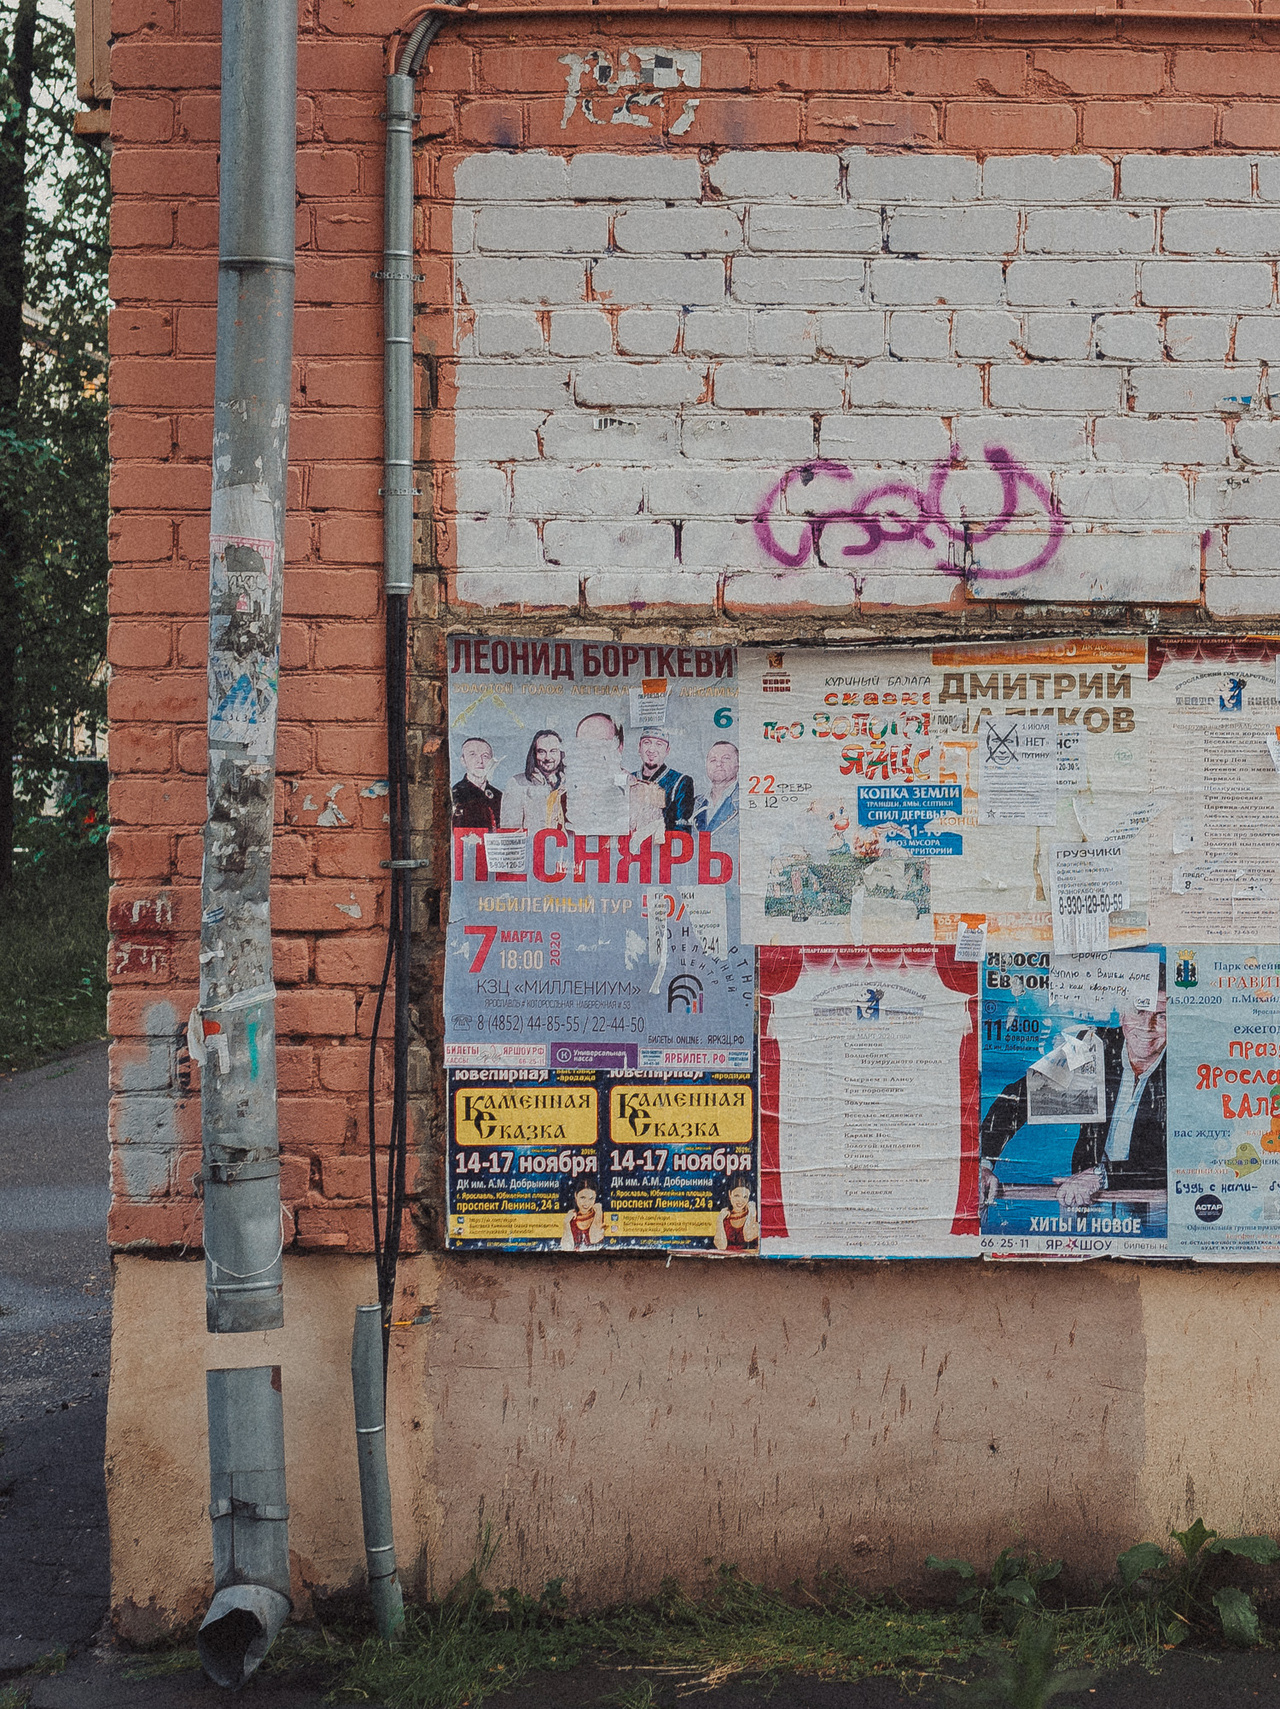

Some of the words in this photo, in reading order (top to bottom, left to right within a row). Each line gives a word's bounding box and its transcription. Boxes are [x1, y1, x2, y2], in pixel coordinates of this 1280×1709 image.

[451, 639, 574, 680] ЛЕОНИД
[582, 643, 738, 678] БОРТКЕВИ
[825, 676, 879, 687] КУРИНЫЙ
[939, 665, 1131, 704] ДМИТРИЙ
[749, 775, 776, 794] 22
[859, 786, 909, 799] КОПКА
[912, 786, 960, 799] ЗЕМЛИ
[868, 810, 900, 821] СПИЛ
[908, 839, 941, 847] МУСОРА
[1057, 848, 1121, 858] ГРУЗЧИКИ
[478, 895, 597, 914] ЮБИЛЕЙНЫЙ
[601, 897, 633, 914] ТУР
[464, 925, 498, 974] 7
[500, 930, 543, 943] МАРТА
[550, 931, 561, 966] 2020
[500, 950, 544, 970] 18:00
[1214, 962, 1241, 972] Парк
[477, 979, 509, 996] КЗЦ
[515, 980, 641, 995] «МИЛЛЕНИУМ»
[1169, 996, 1222, 1005] 15.02.2020
[477, 1015, 484, 1030] 8
[488, 1015, 524, 1033] (4852)
[527, 1015, 579, 1032] 44-85-55
[592, 1016, 645, 1032] 22-44-50
[984, 1019, 1001, 1040] 11
[446, 1046, 479, 1054] БИЛЕТЫ
[713, 1054, 726, 1064] РФ
[1196, 1129, 1231, 1140] ждут:
[456, 1152, 514, 1174] 14-17
[519, 1150, 598, 1177] ноября
[610, 1149, 668, 1171] 14-17
[673, 1148, 751, 1175] ноября
[456, 1180, 469, 1190] ДК
[488, 1180, 508, 1188] А.М.
[510, 1179, 559, 1190] Добрынина
[611, 1177, 624, 1188] ДК
[625, 1178, 640, 1186] им.
[642, 1177, 661, 1186] А.М.
[664, 1177, 713, 1188] Добрынина
[456, 1202, 499, 1213] проспект
[501, 1201, 539, 1211] Ленина,
[541, 1201, 552, 1210] 24
[611, 1200, 653, 1211] проспект
[655, 1199, 693, 1209] Ленина,
[695, 1199, 706, 1208] 24
[1029, 1217, 1072, 1232] ХИТЫ
[1077, 1218, 1087, 1232] И
[1092, 1218, 1141, 1233] НОВОЕ
[1046, 1240, 1063, 1250] ЯР
[1080, 1240, 1112, 1250] ШОУ
[1124, 1241, 1157, 1250] билеты
